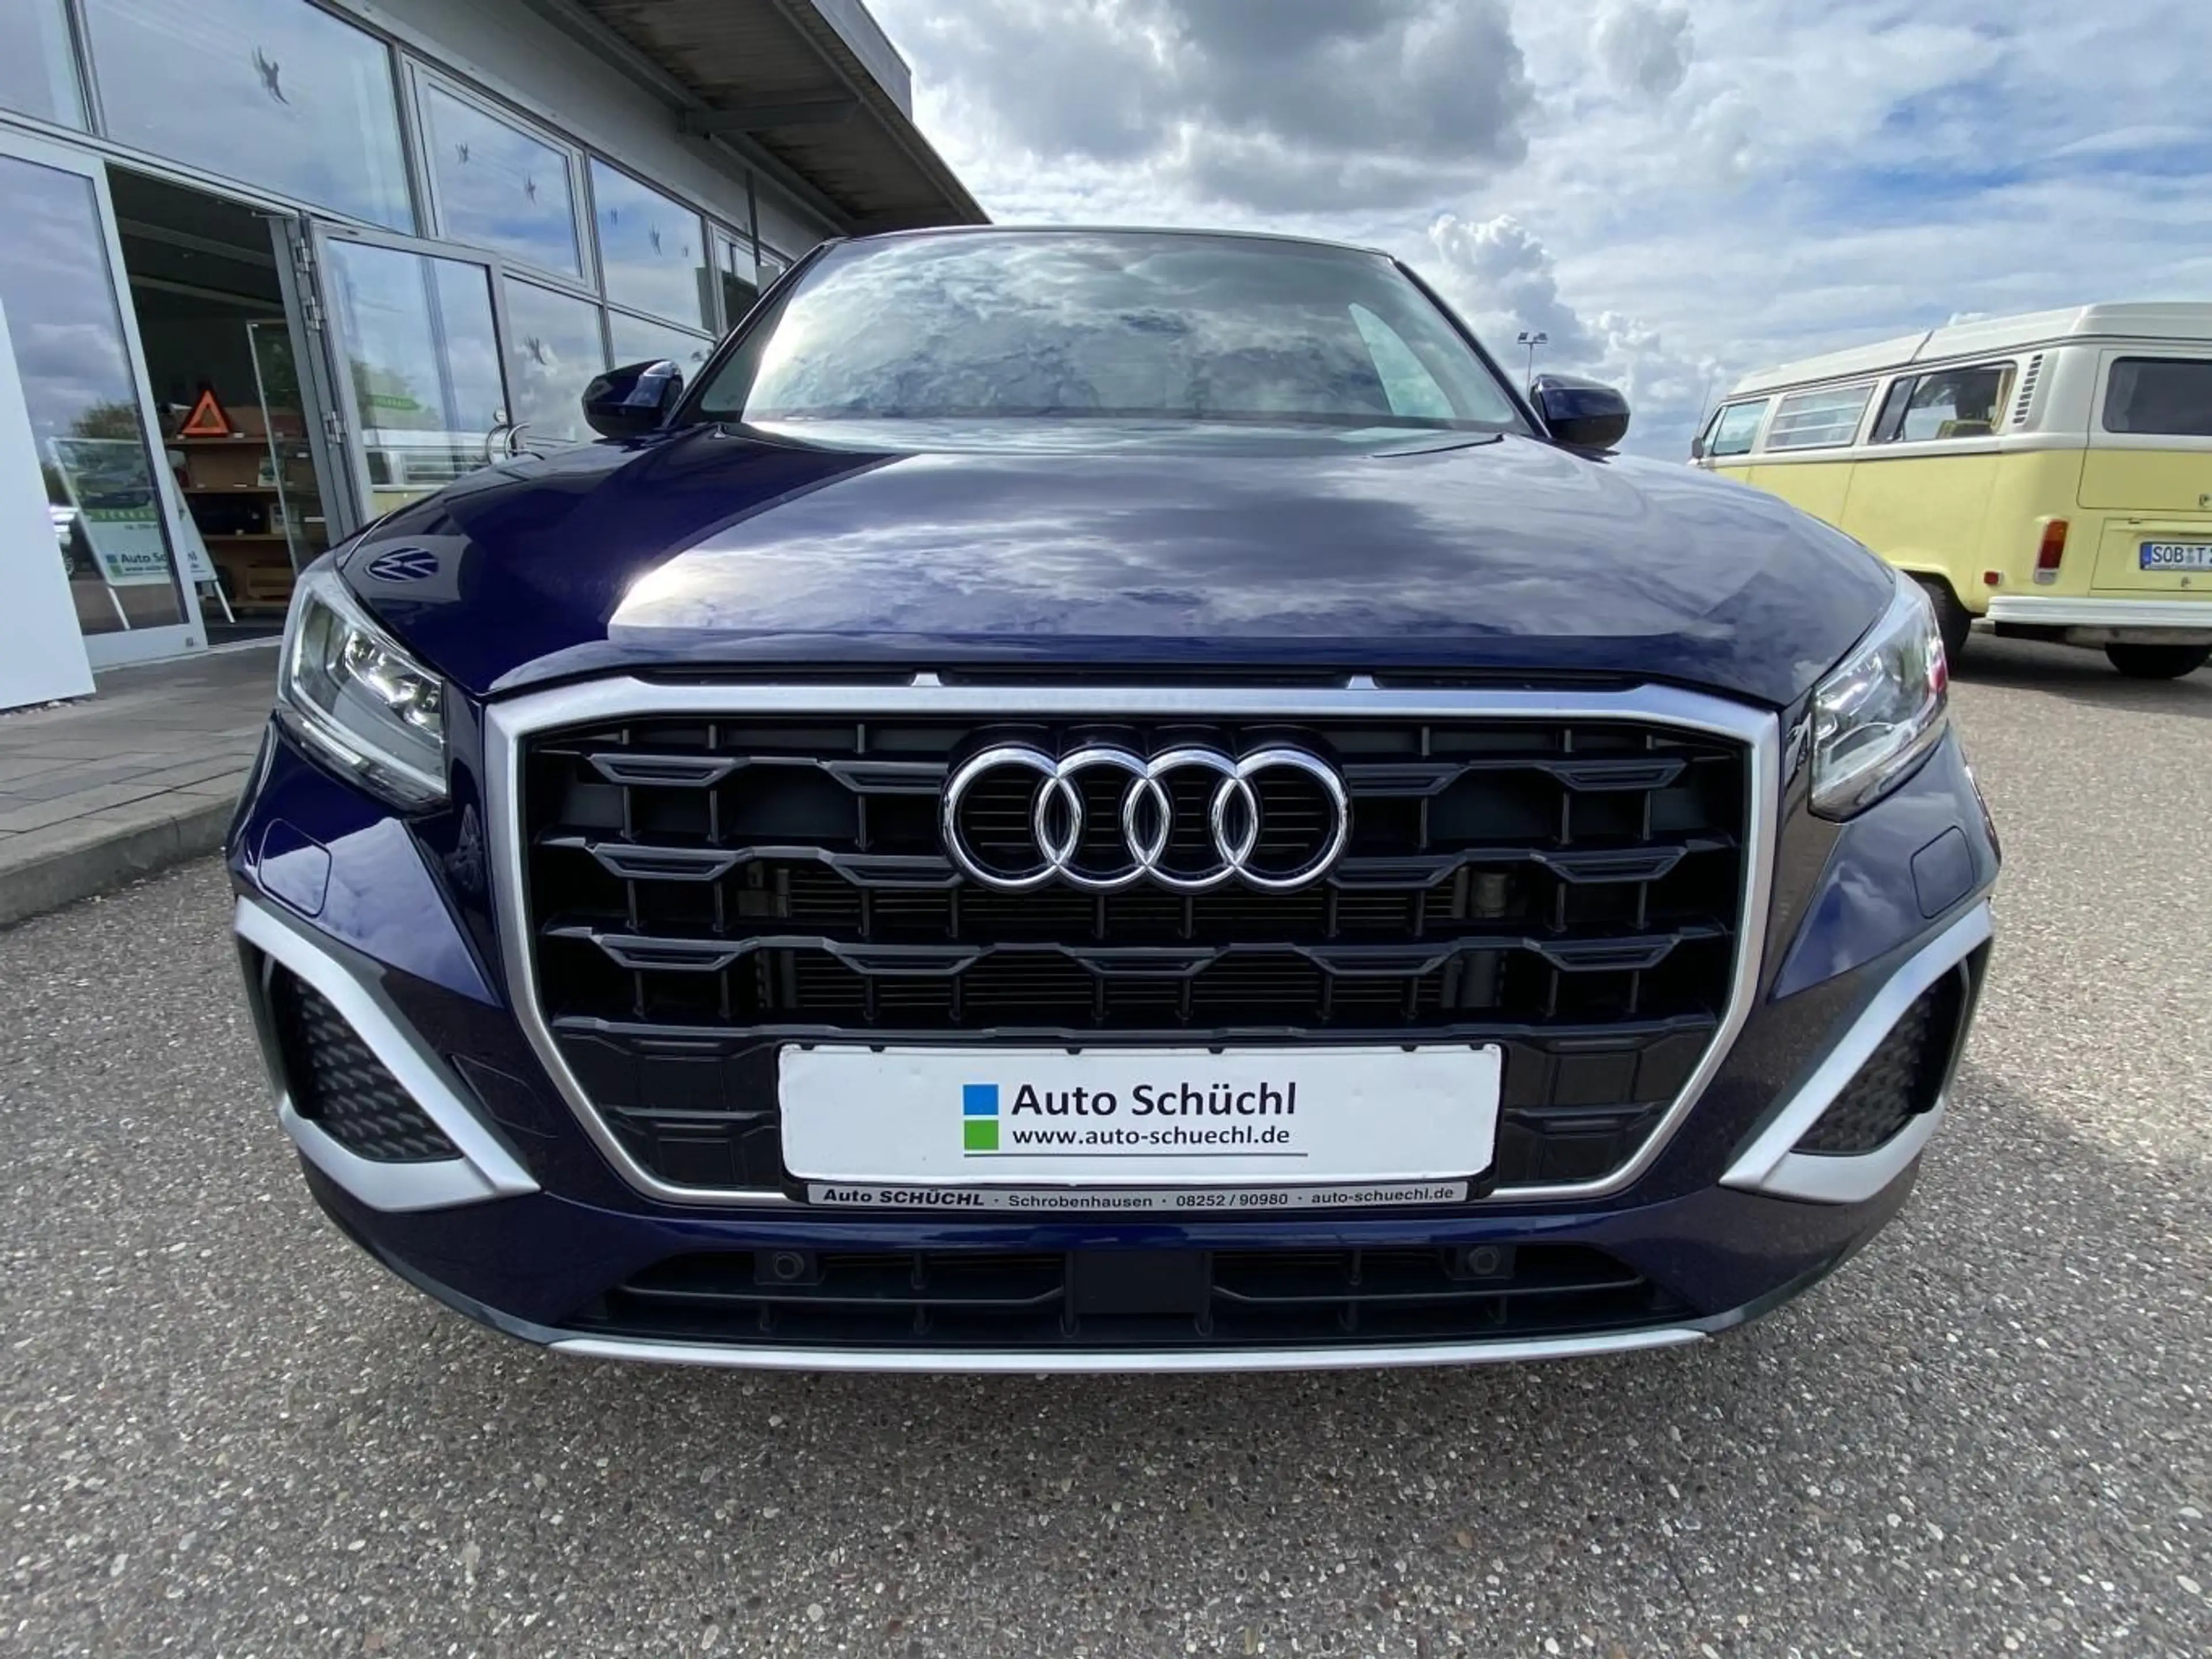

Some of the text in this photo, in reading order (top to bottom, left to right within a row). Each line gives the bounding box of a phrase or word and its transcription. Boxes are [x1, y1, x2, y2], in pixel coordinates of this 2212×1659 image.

[2153, 546, 2184, 563] SOB
[1011, 1081, 1296, 1116] Auto Schüchl
[1012, 1125, 1290, 1145] www.auto-schuechl.de
[823, 1188, 874, 1203] Auto
[879, 1188, 985, 1206] SCHÜCHL
[1008, 1194, 1153, 1208] Schrobenhausen
[1311, 1187, 1455, 1204] auto-schuechl.de
